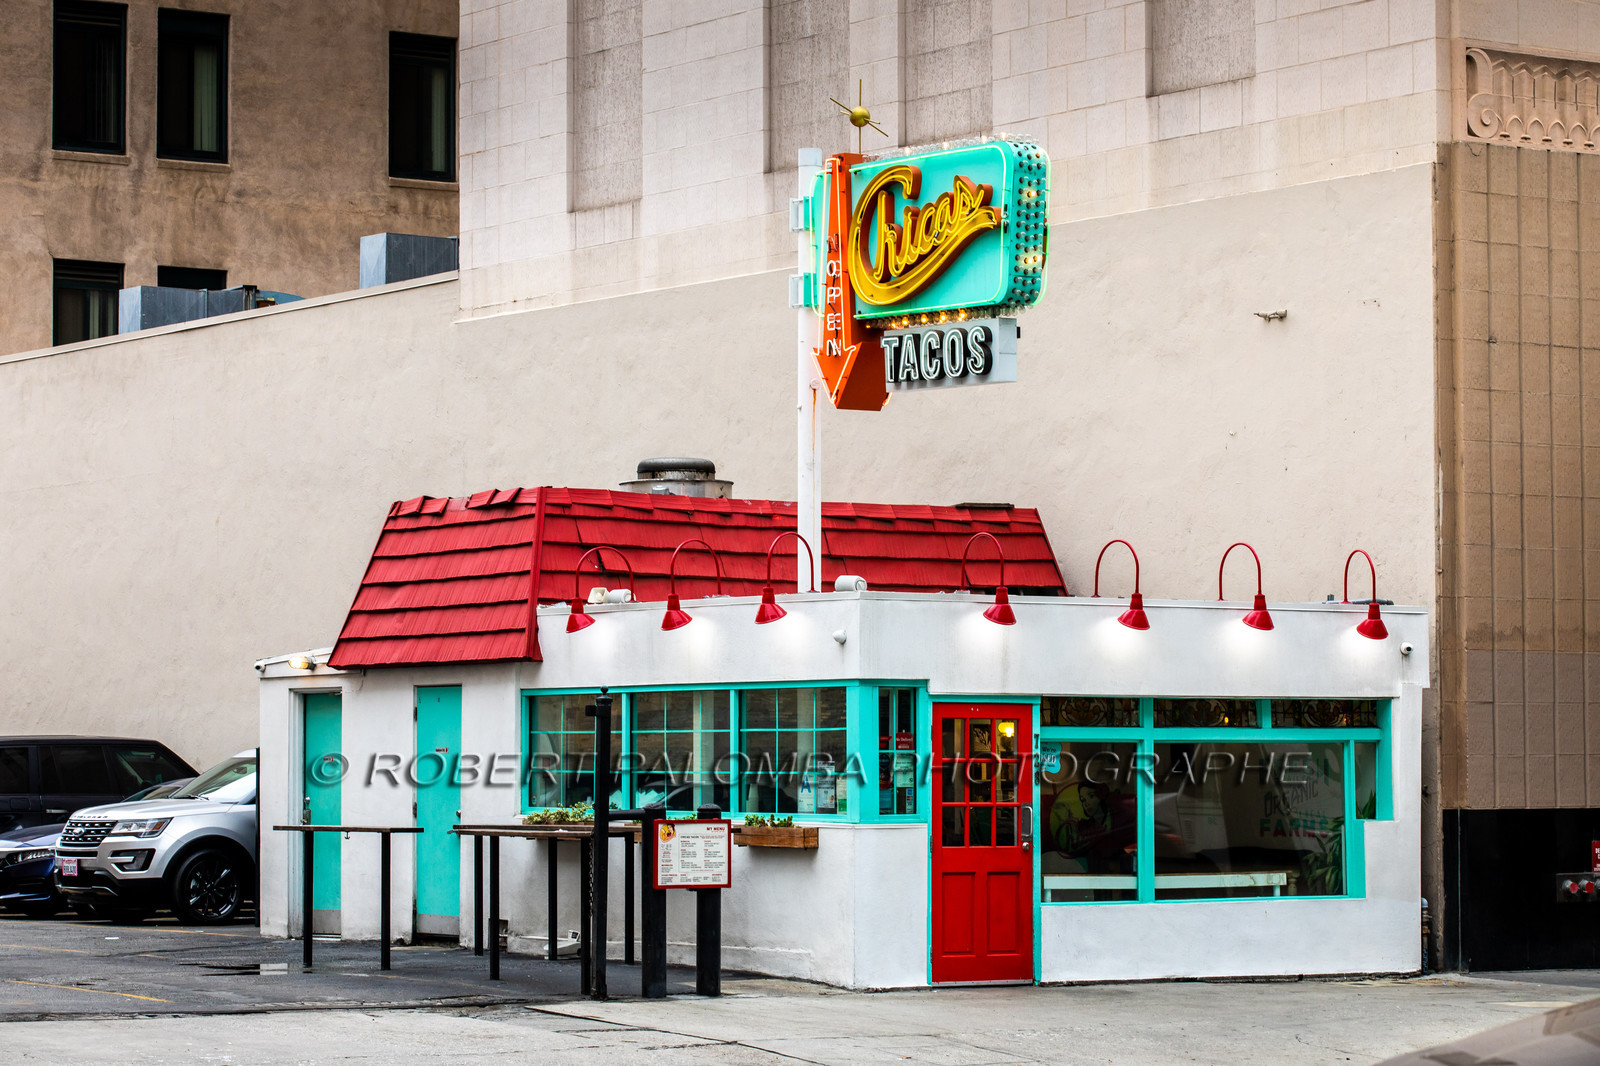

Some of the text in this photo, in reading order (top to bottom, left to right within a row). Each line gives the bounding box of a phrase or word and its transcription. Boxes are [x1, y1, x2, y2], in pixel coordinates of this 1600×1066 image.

[848, 165, 1001, 305] Chicas
[826, 259, 841, 357] OPEN
[881, 326, 992, 382] TACOS
